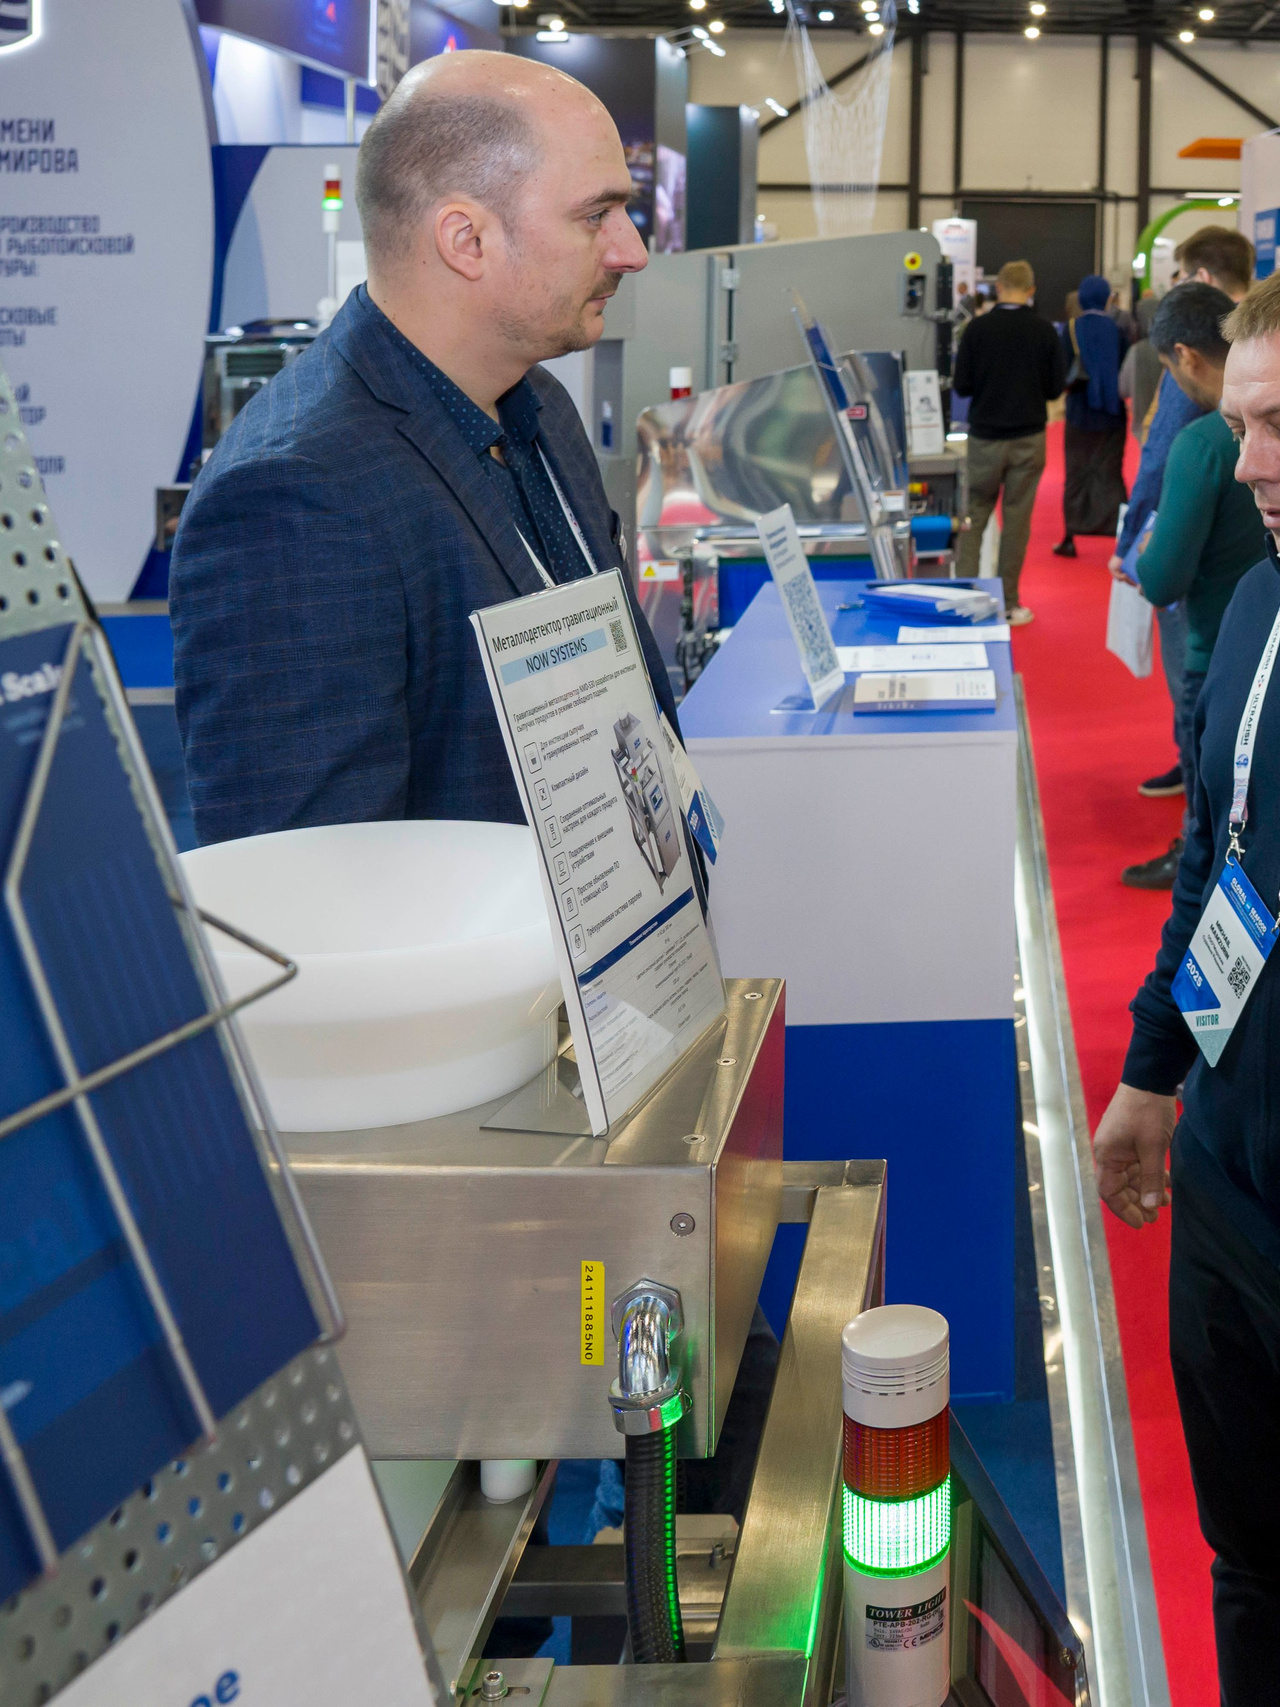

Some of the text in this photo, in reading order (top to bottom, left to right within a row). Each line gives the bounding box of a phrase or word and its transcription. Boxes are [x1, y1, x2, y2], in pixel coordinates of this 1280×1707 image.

[492, 596, 619, 653] Металлодетектор гравитационный
[526, 638, 588, 673] NOW SYSTEMS
[1243, 693, 1260, 746] ULTRAFISH
[1231, 877, 1247, 902] GLOBAL
[1250, 907, 1267, 933] SEAFOOD
[1186, 958, 1203, 988] 2025
[1196, 1014, 1219, 1027] VISITOR
[869, 1608, 913, 1618] TOWER
